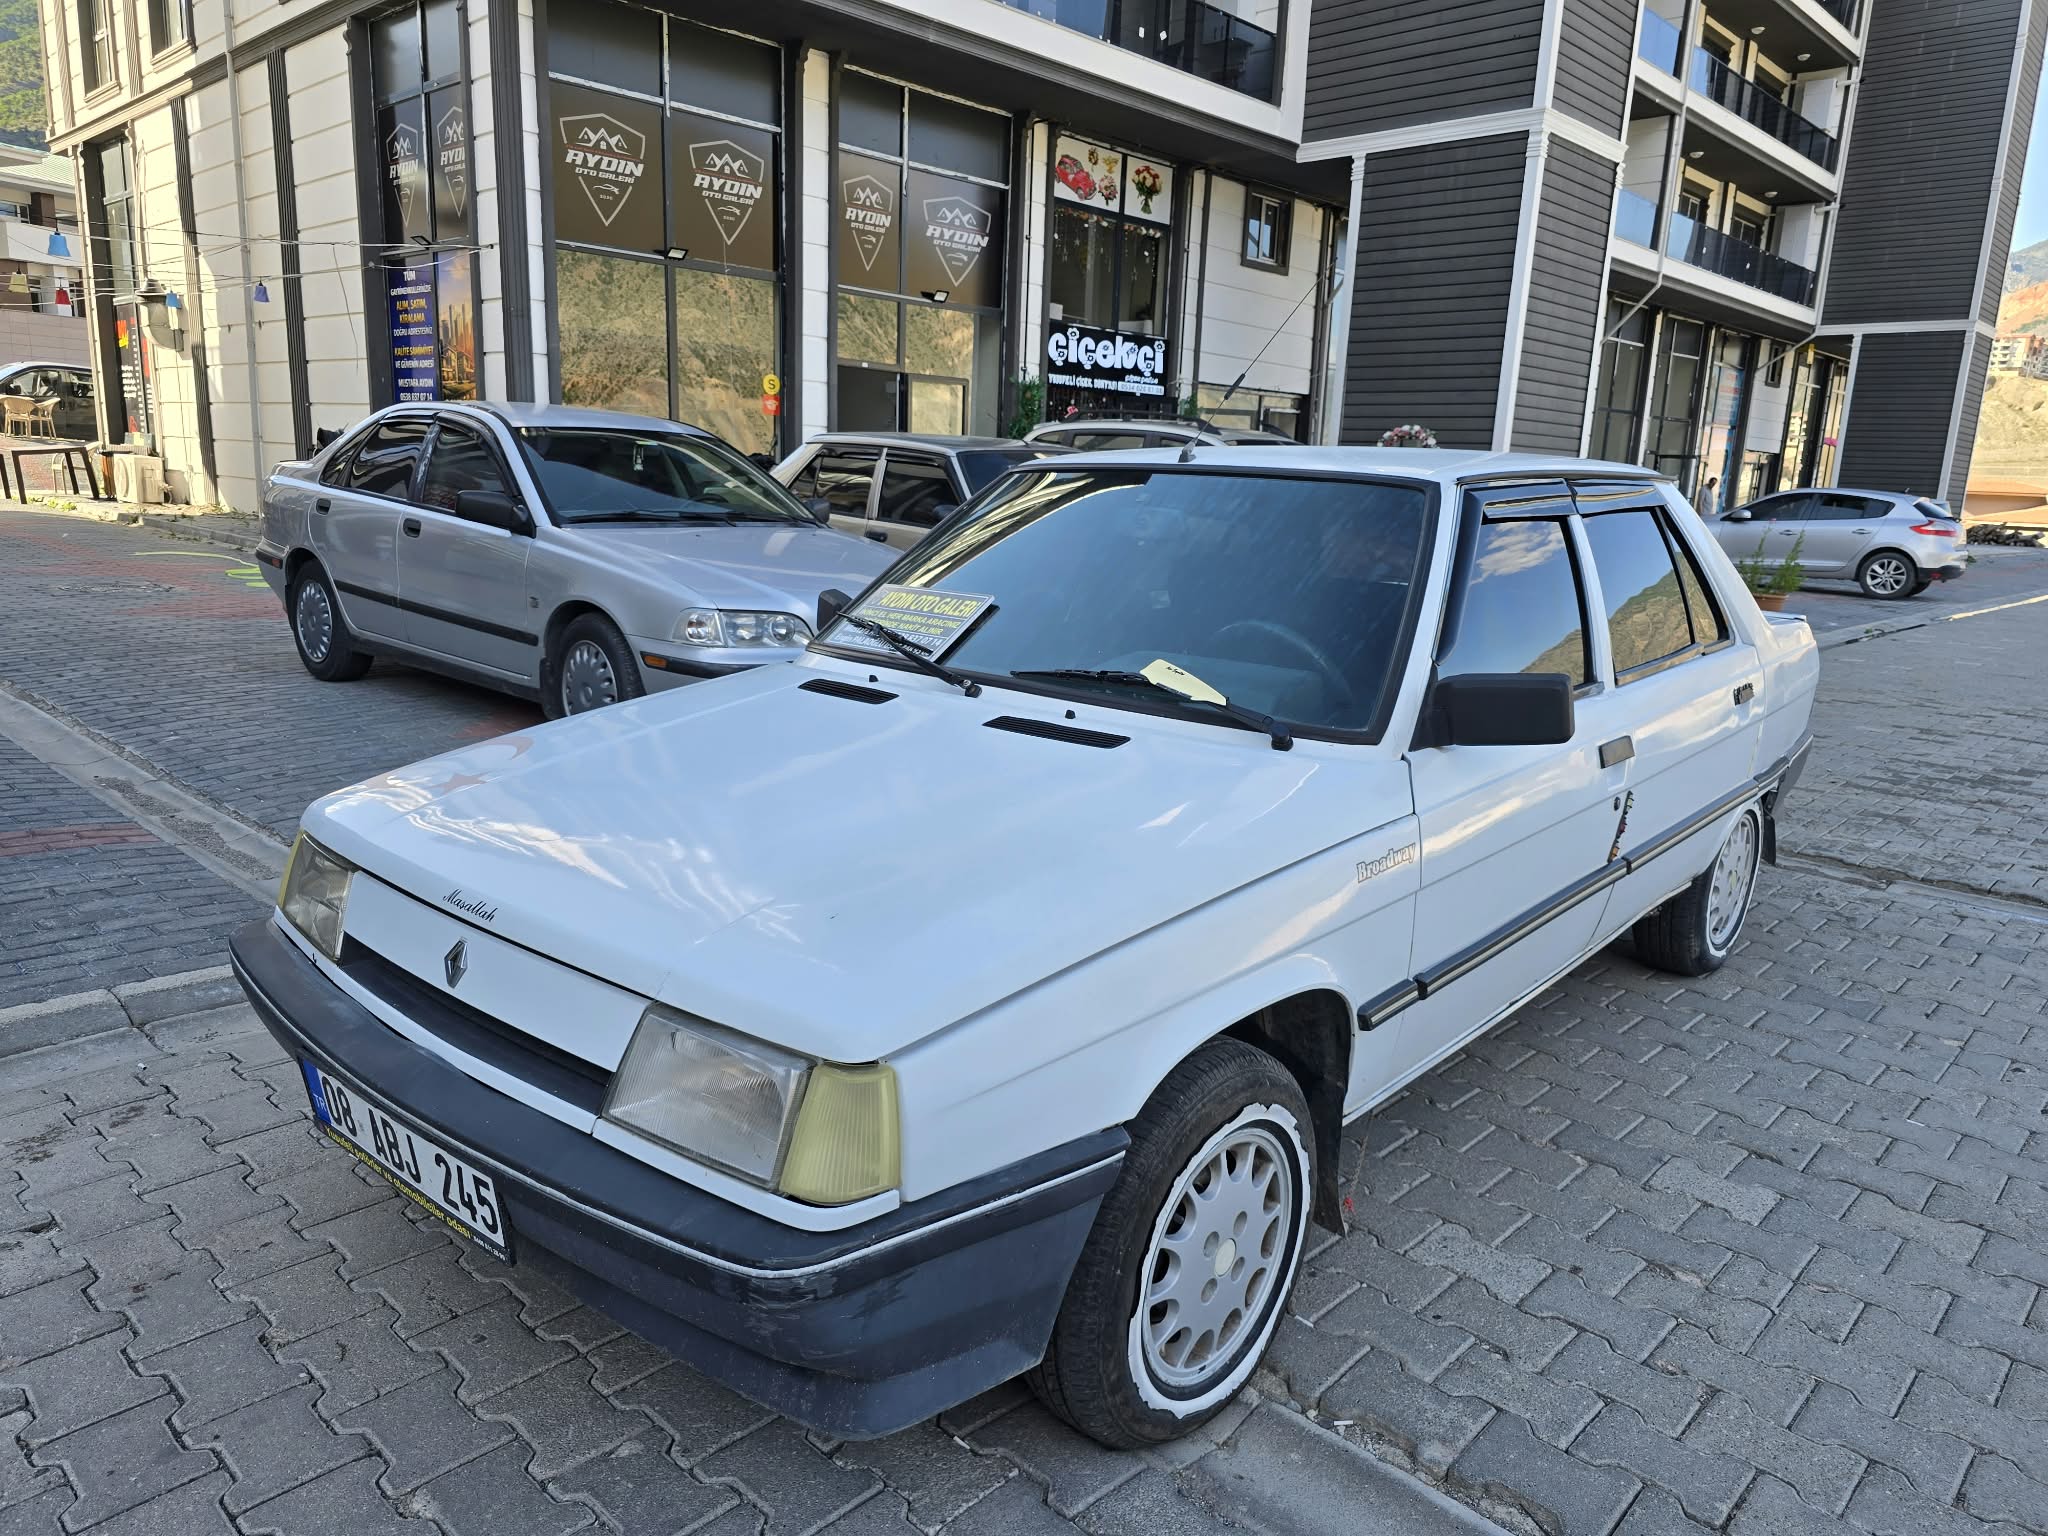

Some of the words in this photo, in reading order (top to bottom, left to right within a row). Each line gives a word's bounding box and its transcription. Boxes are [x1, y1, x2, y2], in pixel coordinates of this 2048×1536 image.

[440, 147, 465, 166] AYDI
[565, 149, 644, 177] AYDIN
[390, 159, 419, 178] AYDIN
[575, 167, 597, 177] OTO
[693, 173, 763, 199] AYDIN
[702, 190, 721, 199] OTO
[845, 207, 891, 228] AYDIN
[926, 225, 989, 247] AYDIN
[933, 239, 951, 247] OTO
[403, 268, 416, 281] TÜM
[768, 378, 776, 390] S
[880, 591, 916, 609] AYDIN
[910, 594, 941, 612] OTO
[934, 597, 981, 617] GALERİ
[1356, 842, 1416, 883] Broadway
[312, 1093, 327, 1111] TR
[321, 1075, 358, 1137] 08
[368, 1108, 421, 1184] ABJ
[434, 1153, 499, 1235] 245
